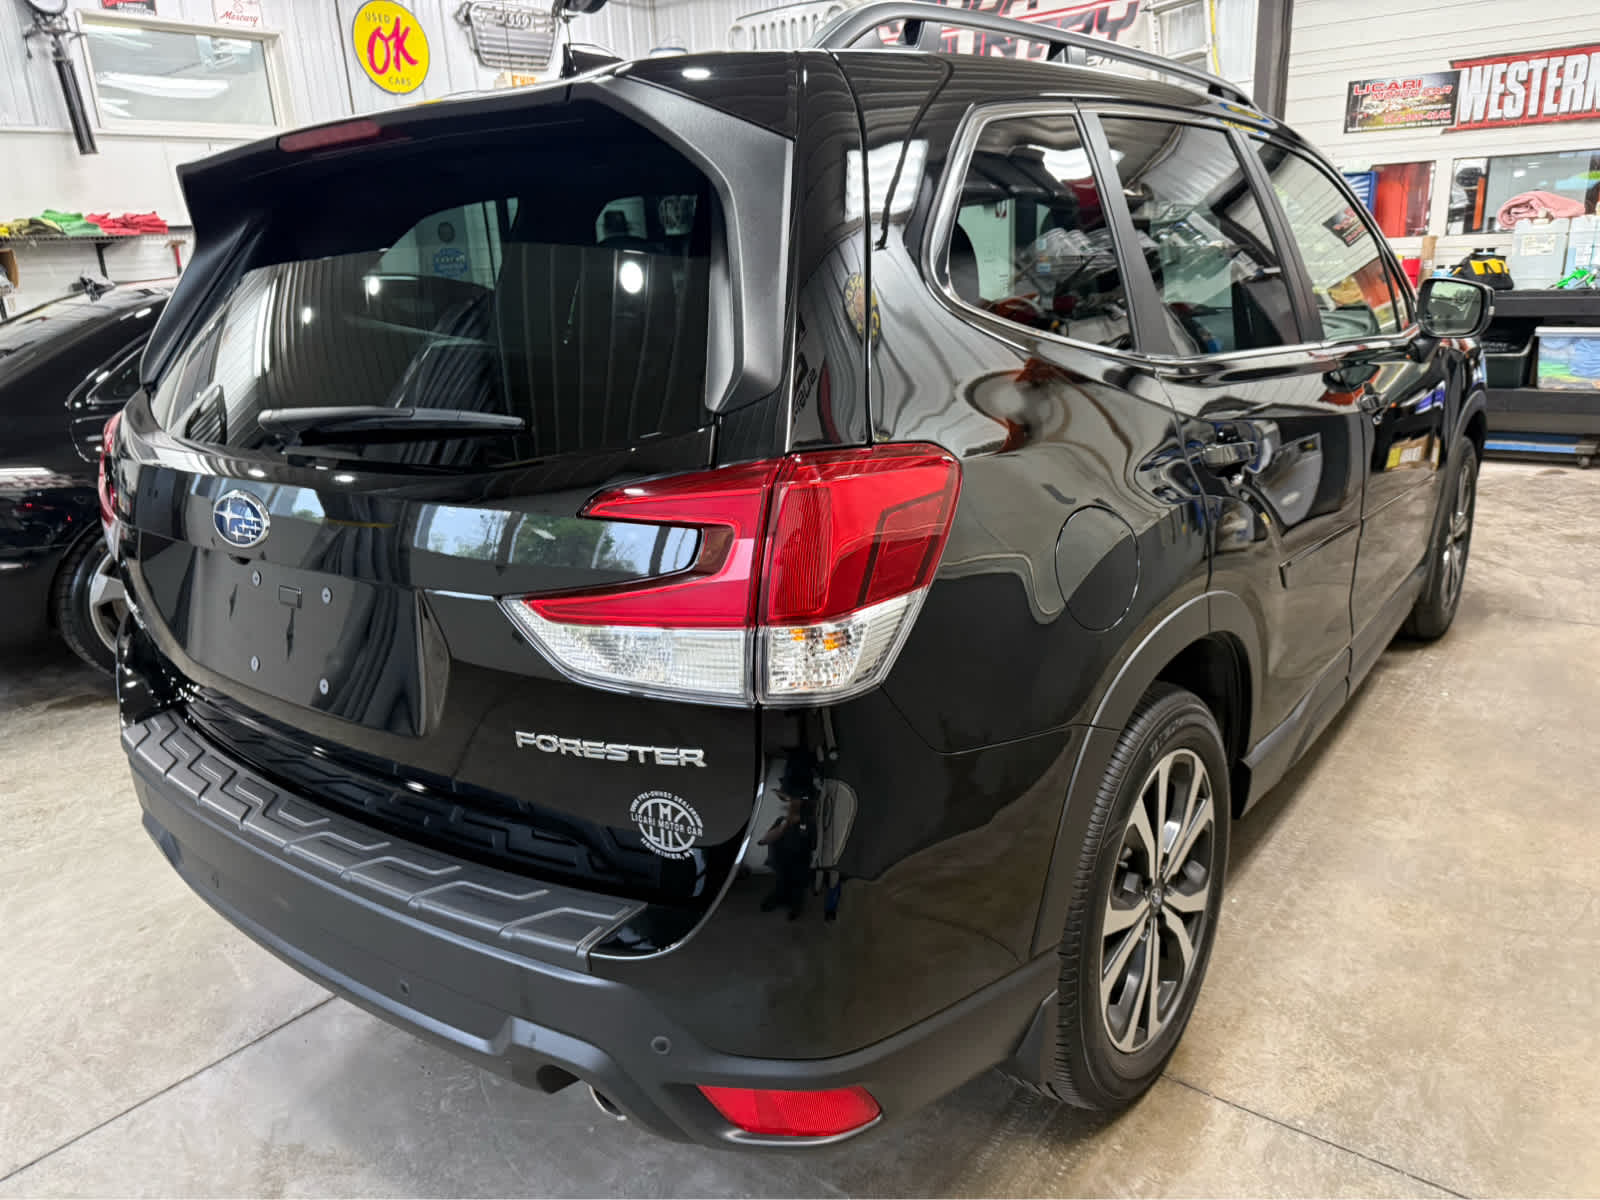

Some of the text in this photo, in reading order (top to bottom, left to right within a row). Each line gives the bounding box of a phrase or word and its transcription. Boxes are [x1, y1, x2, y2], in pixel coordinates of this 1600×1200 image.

[365, 11, 391, 24] USED
[367, 16, 419, 75] OK
[388, 76, 412, 87] CARS
[1353, 79, 1423, 95] LICARI
[514, 730, 708, 768] FORESTER
[631, 812, 703, 837] LICARI MOTOR CAR
